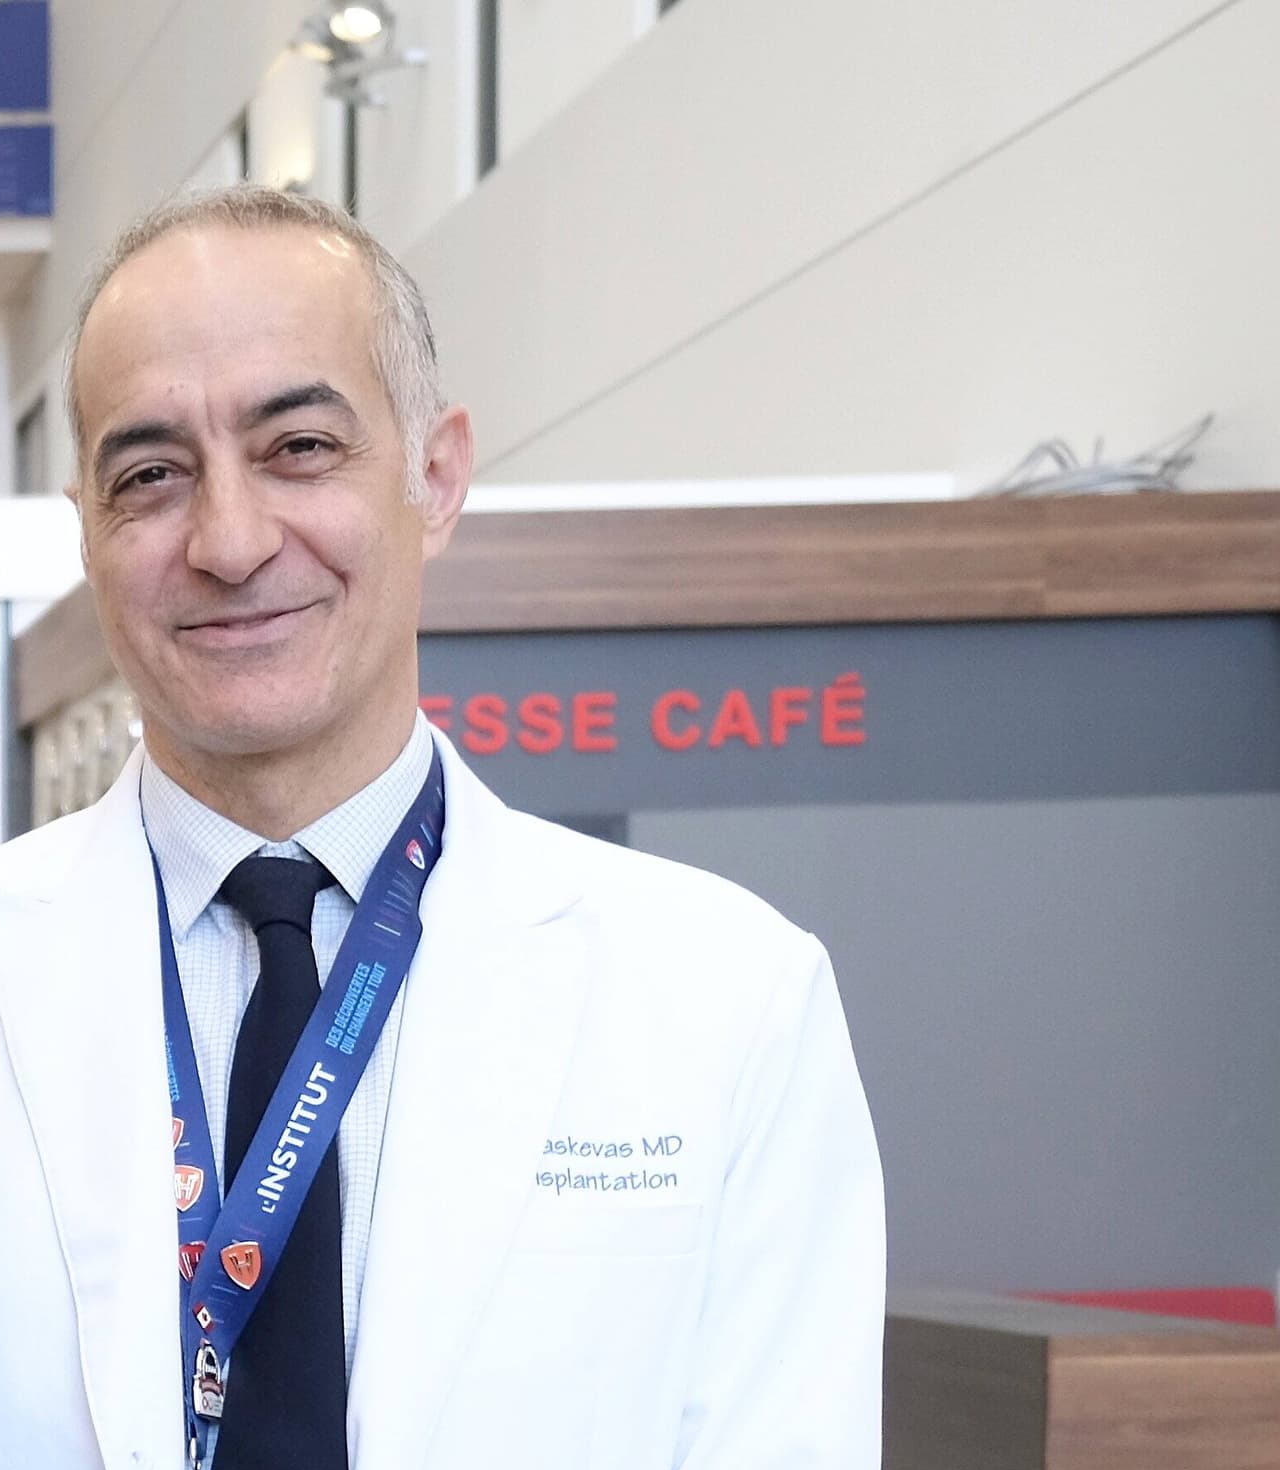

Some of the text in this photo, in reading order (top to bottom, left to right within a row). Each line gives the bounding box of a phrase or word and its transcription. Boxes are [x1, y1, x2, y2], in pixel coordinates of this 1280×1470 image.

[652, 672, 867, 751] CAFÉ
[368, 961, 386, 988] TOUT
[256, 1061, 336, 1214] L'INSTITUT
[642, 1135, 683, 1156] MD
